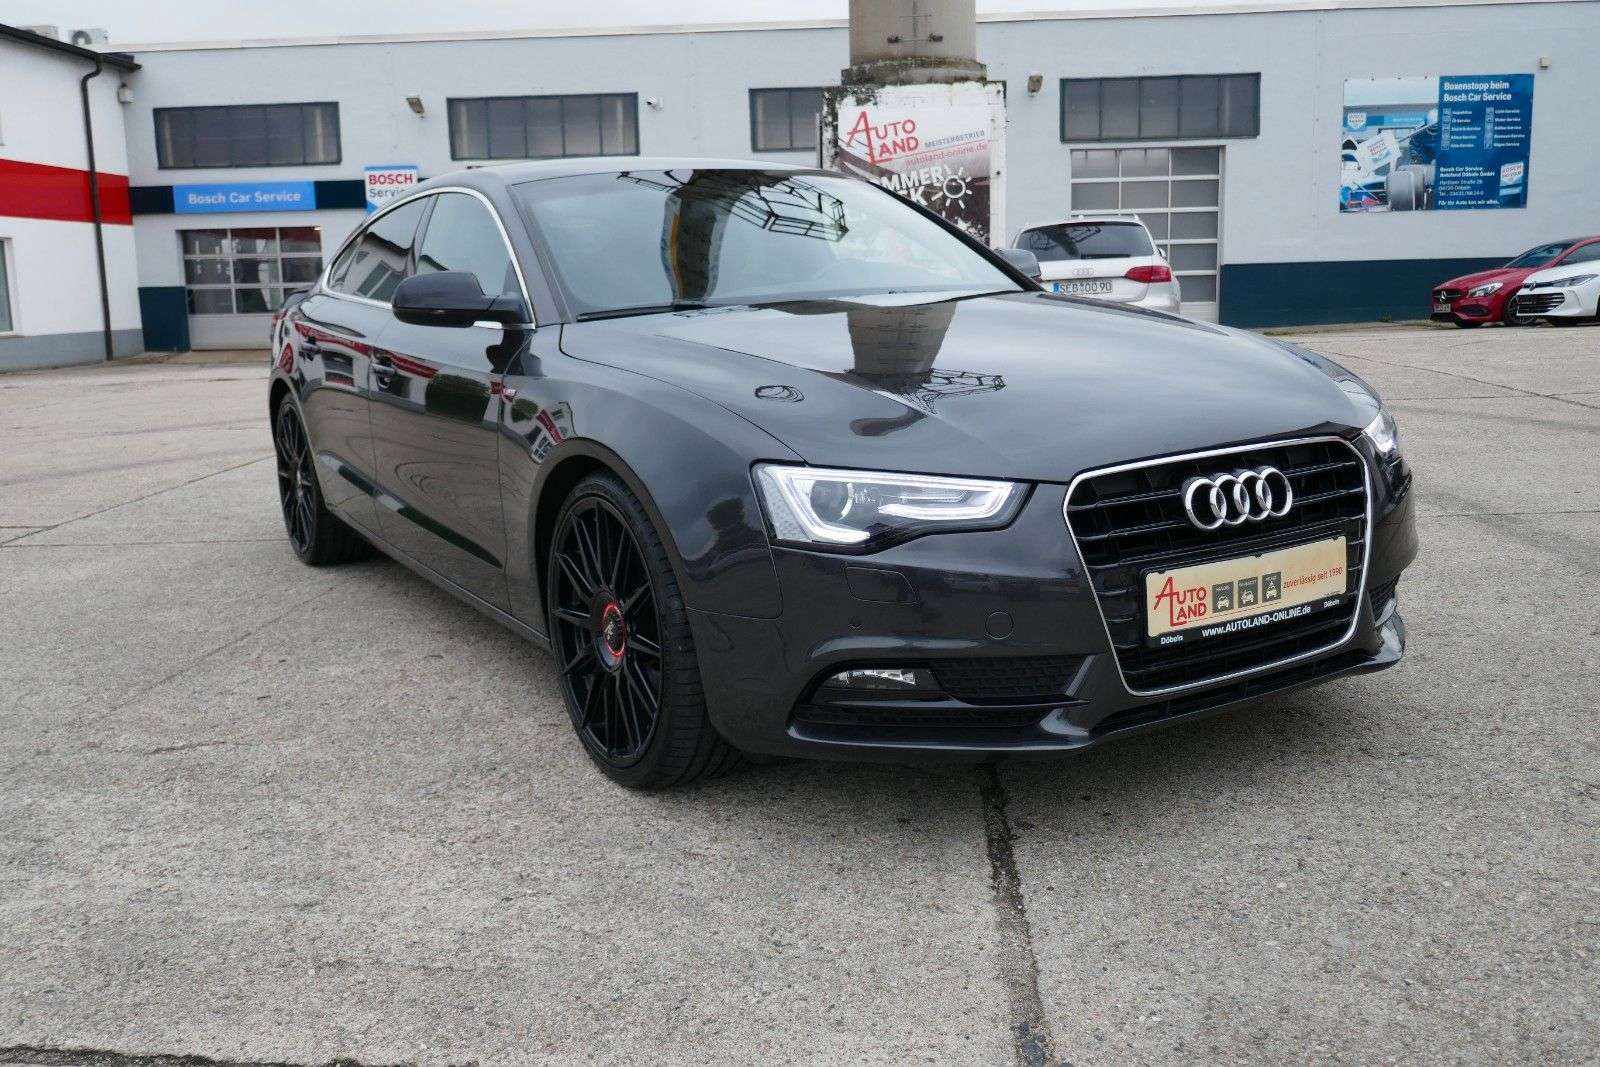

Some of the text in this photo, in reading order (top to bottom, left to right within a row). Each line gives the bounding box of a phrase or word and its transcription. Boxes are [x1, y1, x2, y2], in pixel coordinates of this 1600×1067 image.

[1444, 81, 1510, 92] Boxenstopp beim
[1444, 92, 1512, 102] Bosch Car Service
[847, 111, 917, 148] AUTO
[925, 129, 985, 148] MEISTERBETRIEB
[868, 137, 919, 165] LAND
[368, 174, 413, 185] BOSCH
[880, 166, 945, 192] MMER
[188, 190, 301, 205] Bosch Car Service
[1060, 283, 1079, 293] SEB
[1283, 574, 1316, 588] zuverlässig
[1317, 568, 1328, 580] seit
[1329, 567, 1343, 577] 1990
[1154, 576, 1207, 610] AUTO
[1170, 601, 1208, 627] LAND
[1201, 605, 1311, 637] www.AUTOLAND-ONLINE.de
[1160, 635, 1184, 645] Döbeln
